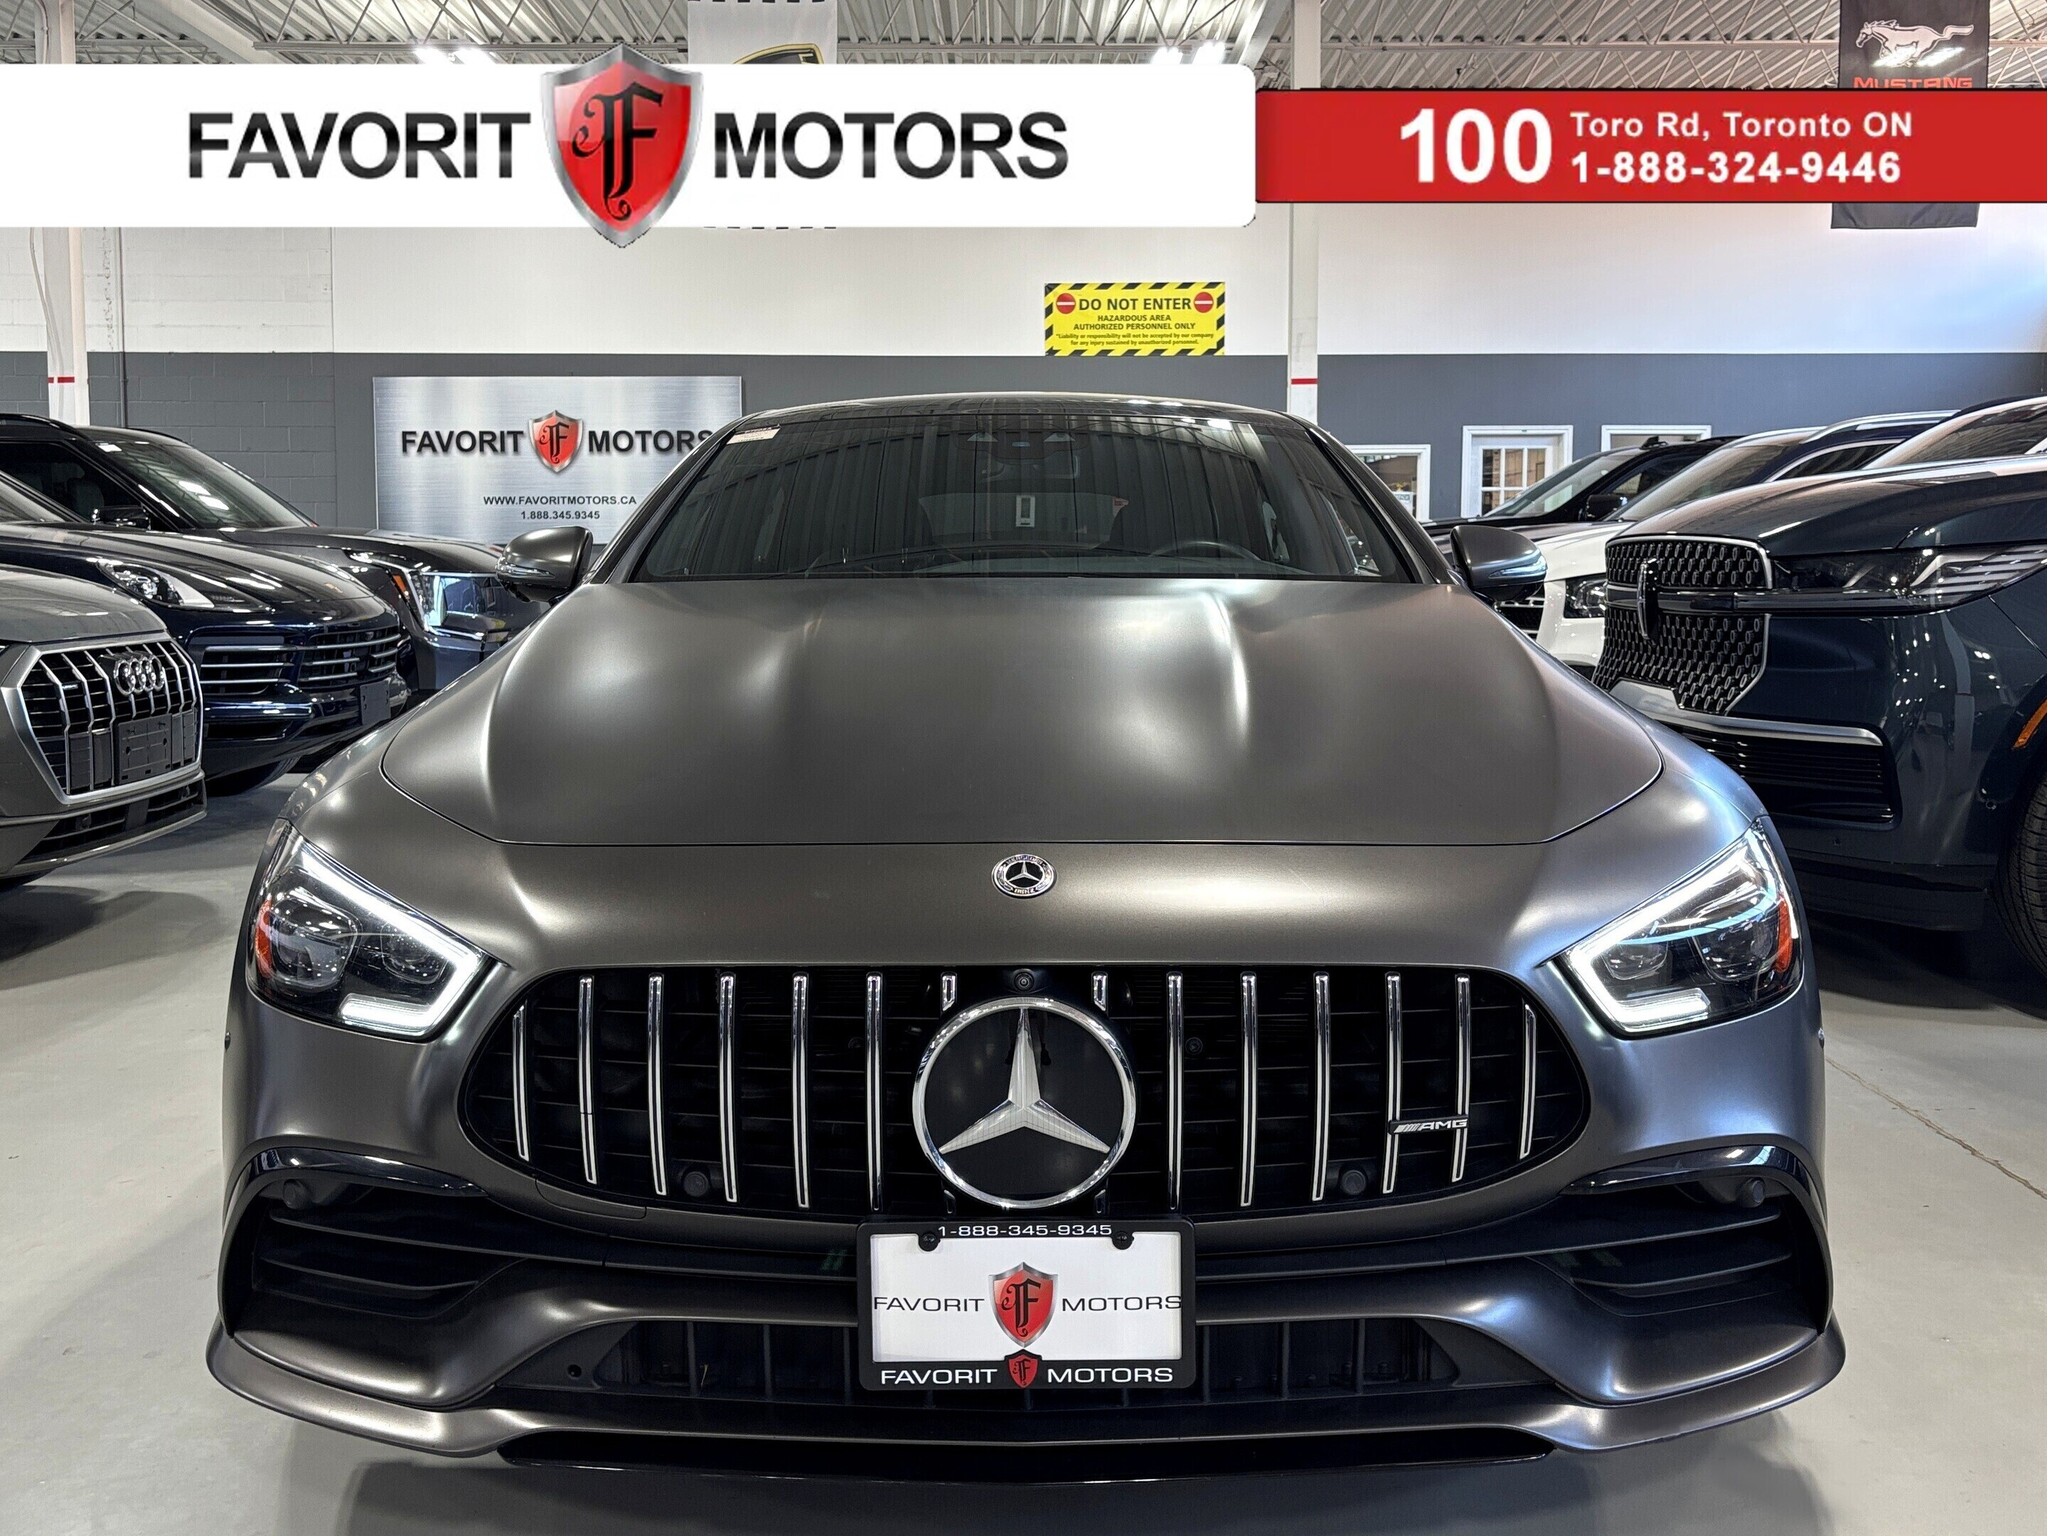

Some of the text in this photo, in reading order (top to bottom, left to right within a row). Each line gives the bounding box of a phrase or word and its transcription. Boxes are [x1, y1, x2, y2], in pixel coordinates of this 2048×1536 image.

[1853, 77, 1973, 88] MUSTANG
[1079, 298, 1192, 311] DO NOT ENTER
[1097, 314, 1147, 322] HAZARDOUS
[1073, 323, 1124, 331] AUTHORIZED
[1175, 322, 1196, 330] ONLY
[401, 430, 524, 454] FAVORIT
[483, 495, 637, 505] WWW.FAVORITMOTORS.CA
[520, 511, 600, 520] 1.888.345.9345
[1418, 1118, 1468, 1132] AMG
[938, 1224, 1112, 1237] 1-888-345-9345
[873, 1296, 985, 1312] FAVORIT
[1061, 1295, 1183, 1312] MOTORS
[880, 1368, 998, 1385] FAVORIT
[1047, 1367, 1173, 1383] MOTORS
